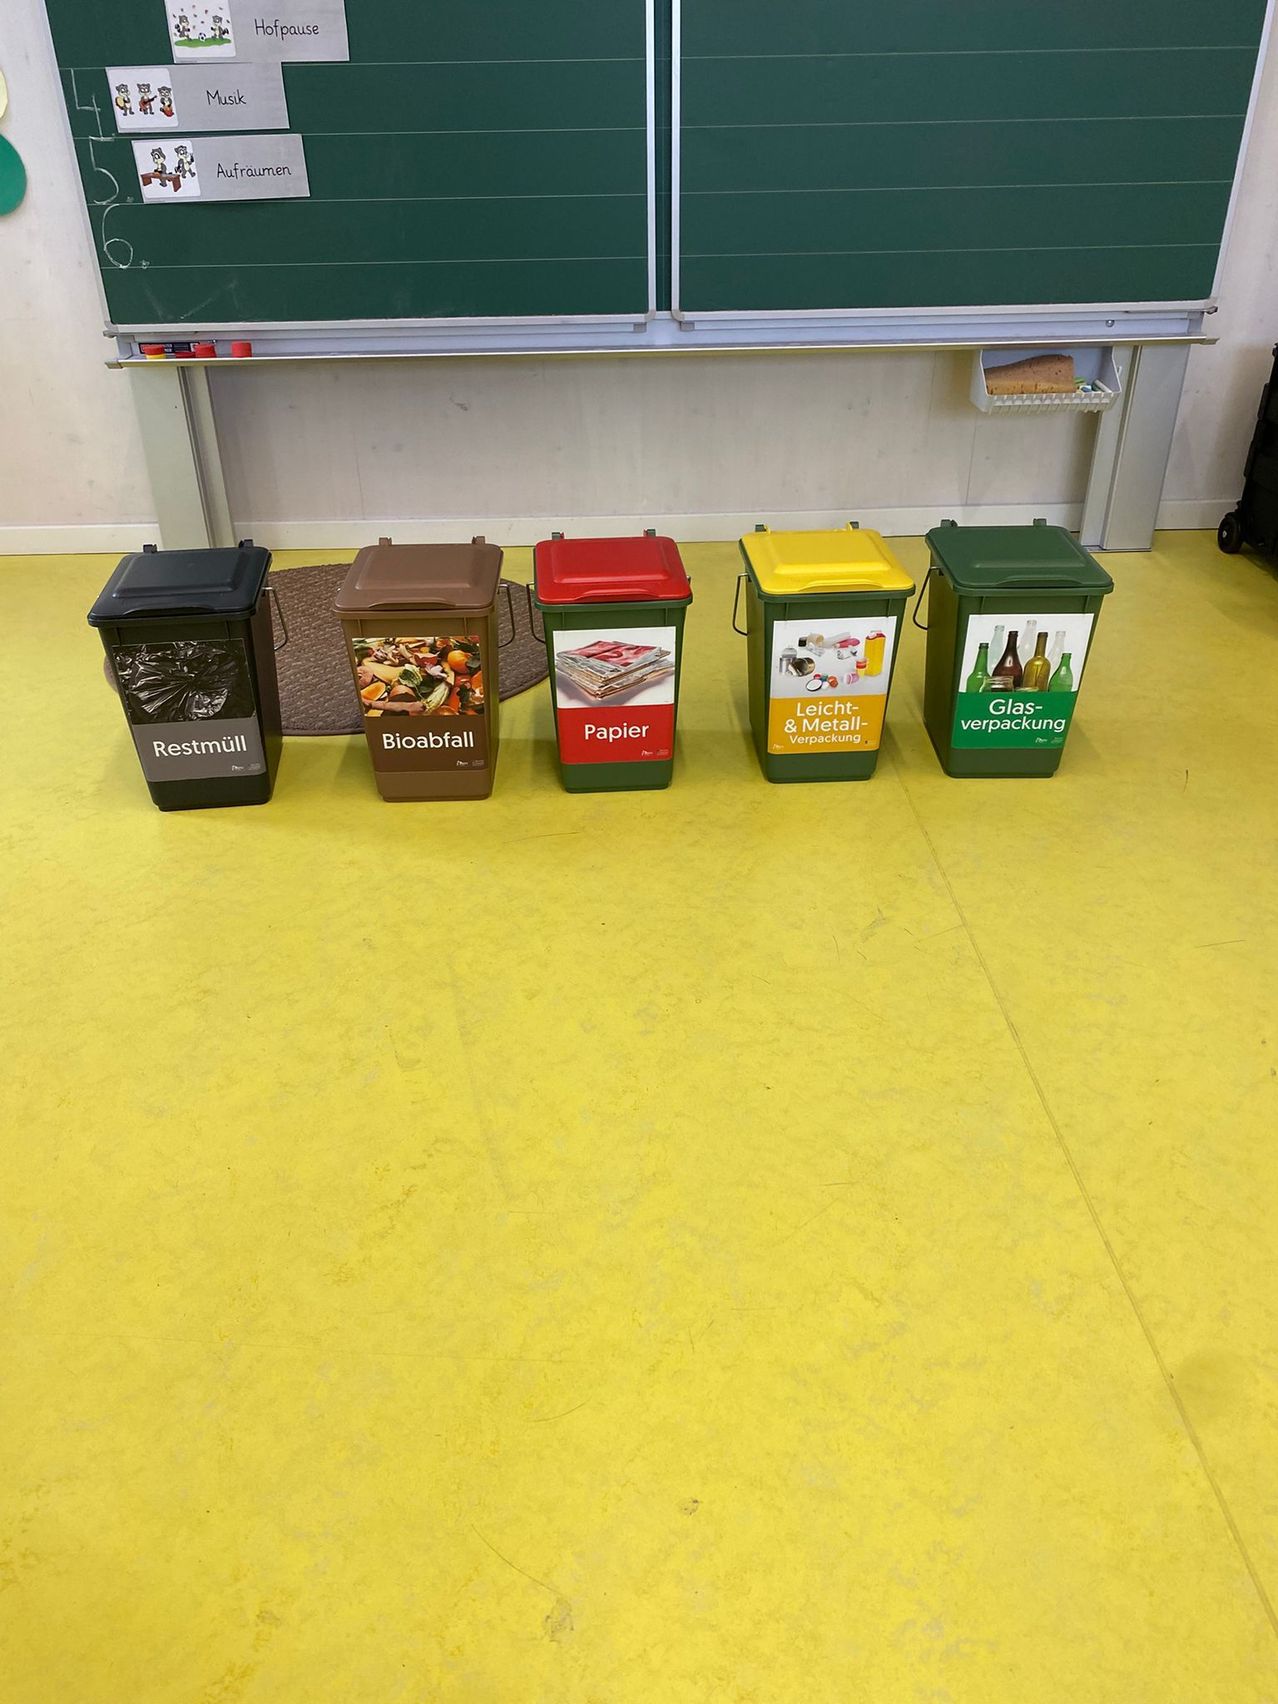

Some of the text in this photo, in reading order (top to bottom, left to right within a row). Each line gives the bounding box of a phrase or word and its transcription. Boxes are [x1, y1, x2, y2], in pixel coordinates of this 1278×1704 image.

[253, 18, 320, 41] Hofpause
[205, 89, 247, 107] Musik
[216, 163, 292, 180] Aufräumen
[796, 700, 859, 717] Leicht-
[989, 698, 1043, 715] Glas-
[584, 722, 650, 743] Papier
[784, 716, 868, 733] & Metall-
[961, 715, 1066, 733] verpackung
[152, 734, 247, 757] Restmüll
[382, 731, 474, 749] Bioabfall
[789, 734, 861, 745] Verpackung
